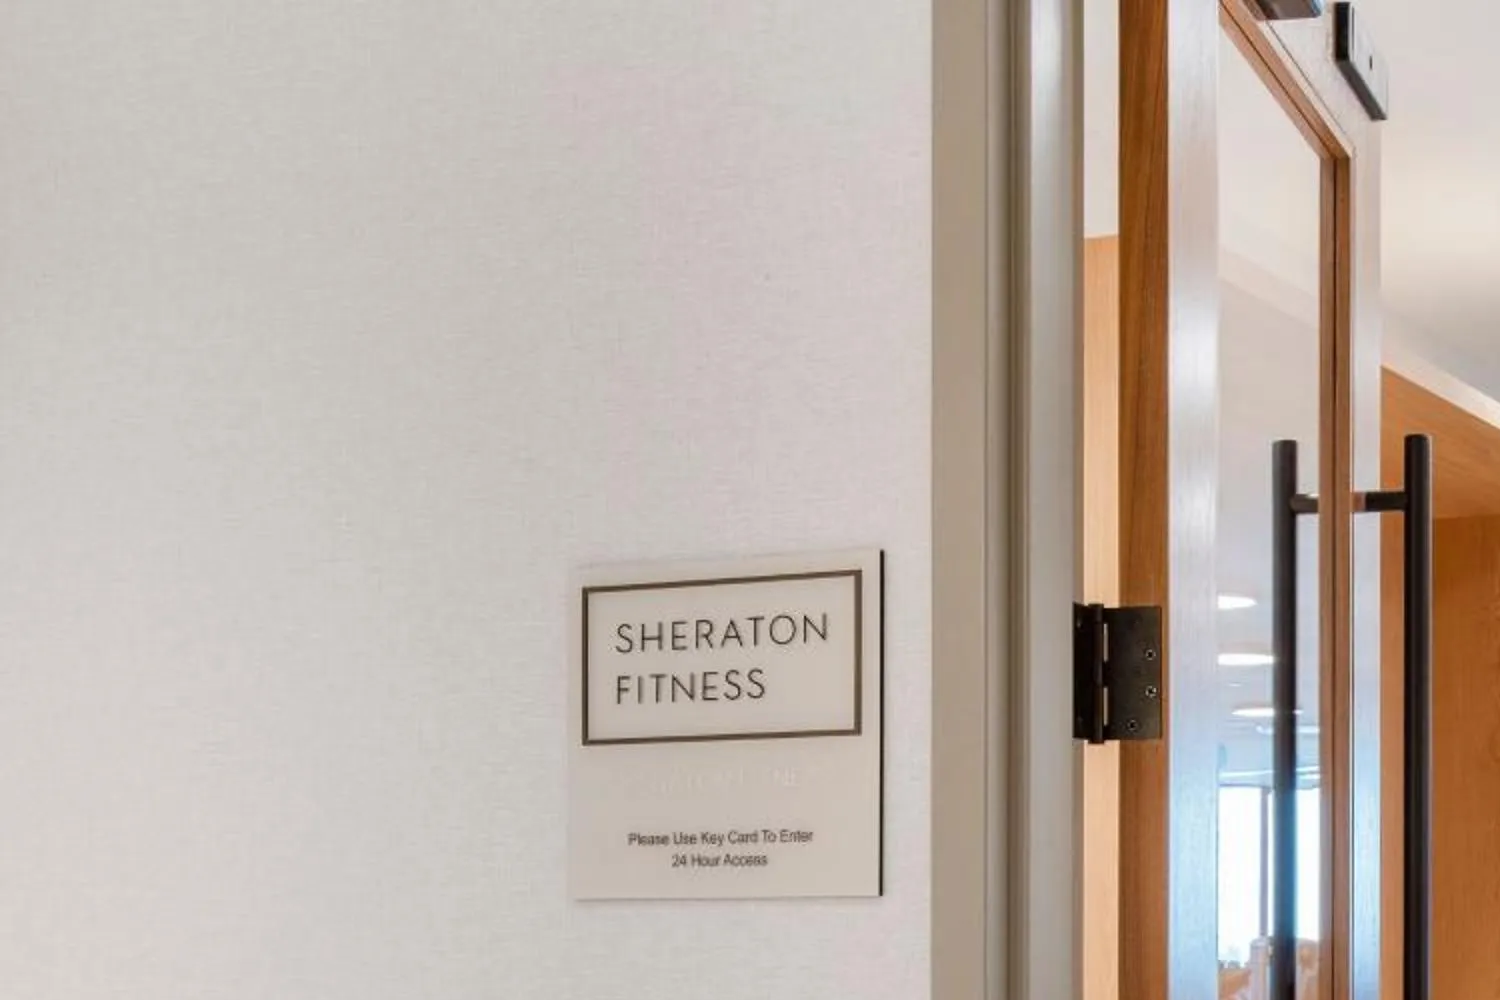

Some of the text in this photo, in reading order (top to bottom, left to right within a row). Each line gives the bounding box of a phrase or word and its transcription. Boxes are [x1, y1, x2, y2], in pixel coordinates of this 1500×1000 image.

[615, 613, 828, 654] SHERATON
[616, 667, 766, 705] FITNESS
[628, 829, 814, 847] Please Use Key Card To Enter
[672, 853, 768, 868] 24 Hour Access
